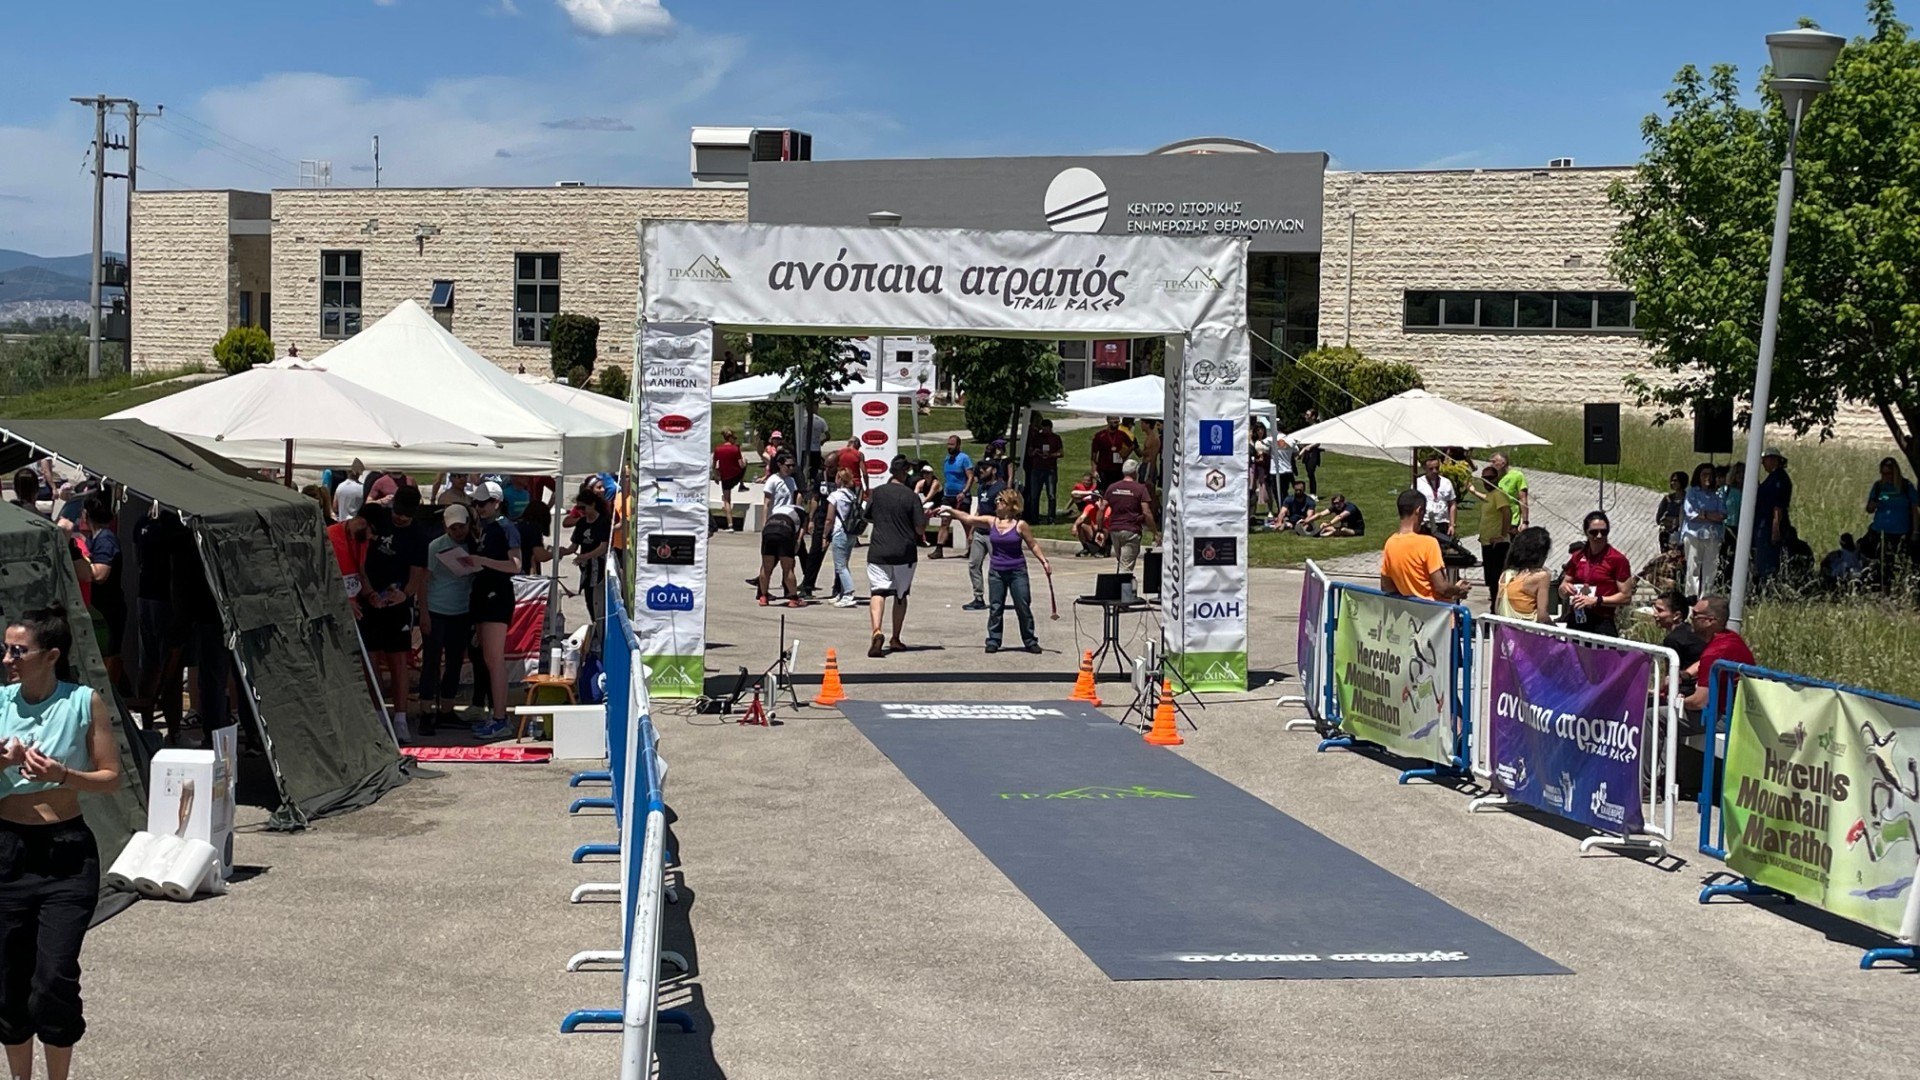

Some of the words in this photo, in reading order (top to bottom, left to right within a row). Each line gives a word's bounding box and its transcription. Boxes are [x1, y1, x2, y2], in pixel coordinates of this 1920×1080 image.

[1127, 202, 1175, 215] ΚΕΝΤΡΟ
[1179, 201, 1242, 215] ΙΣΤΟΡΙΚΗΣ
[1127, 219, 1210, 233] ΕΝΗΜΕΡΩΣΗΣ
[1213, 218, 1305, 233] ΘΕΡΜΟΠΥΛΩΝ
[768, 247, 943, 294] ανόπαια
[960, 254, 1129, 307] ατραπός
[1012, 296, 1060, 311] TRAIL
[1064, 296, 1119, 312] RACE
[650, 366, 686, 377] ΔΗΜΟΣ
[649, 377, 698, 388] ΛΑΜΙΕΩΝ
[651, 592, 689, 603] ΙΟΛΗ
[1193, 602, 1240, 618] ΙΟΛΗ
[1357, 640, 1402, 676] Hercules
[1343, 662, 1391, 698] Mountain
[1351, 687, 1401, 726] Marathon
[1555, 710, 1640, 760] ατραπός
[1735, 775, 1830, 833] Mountain
